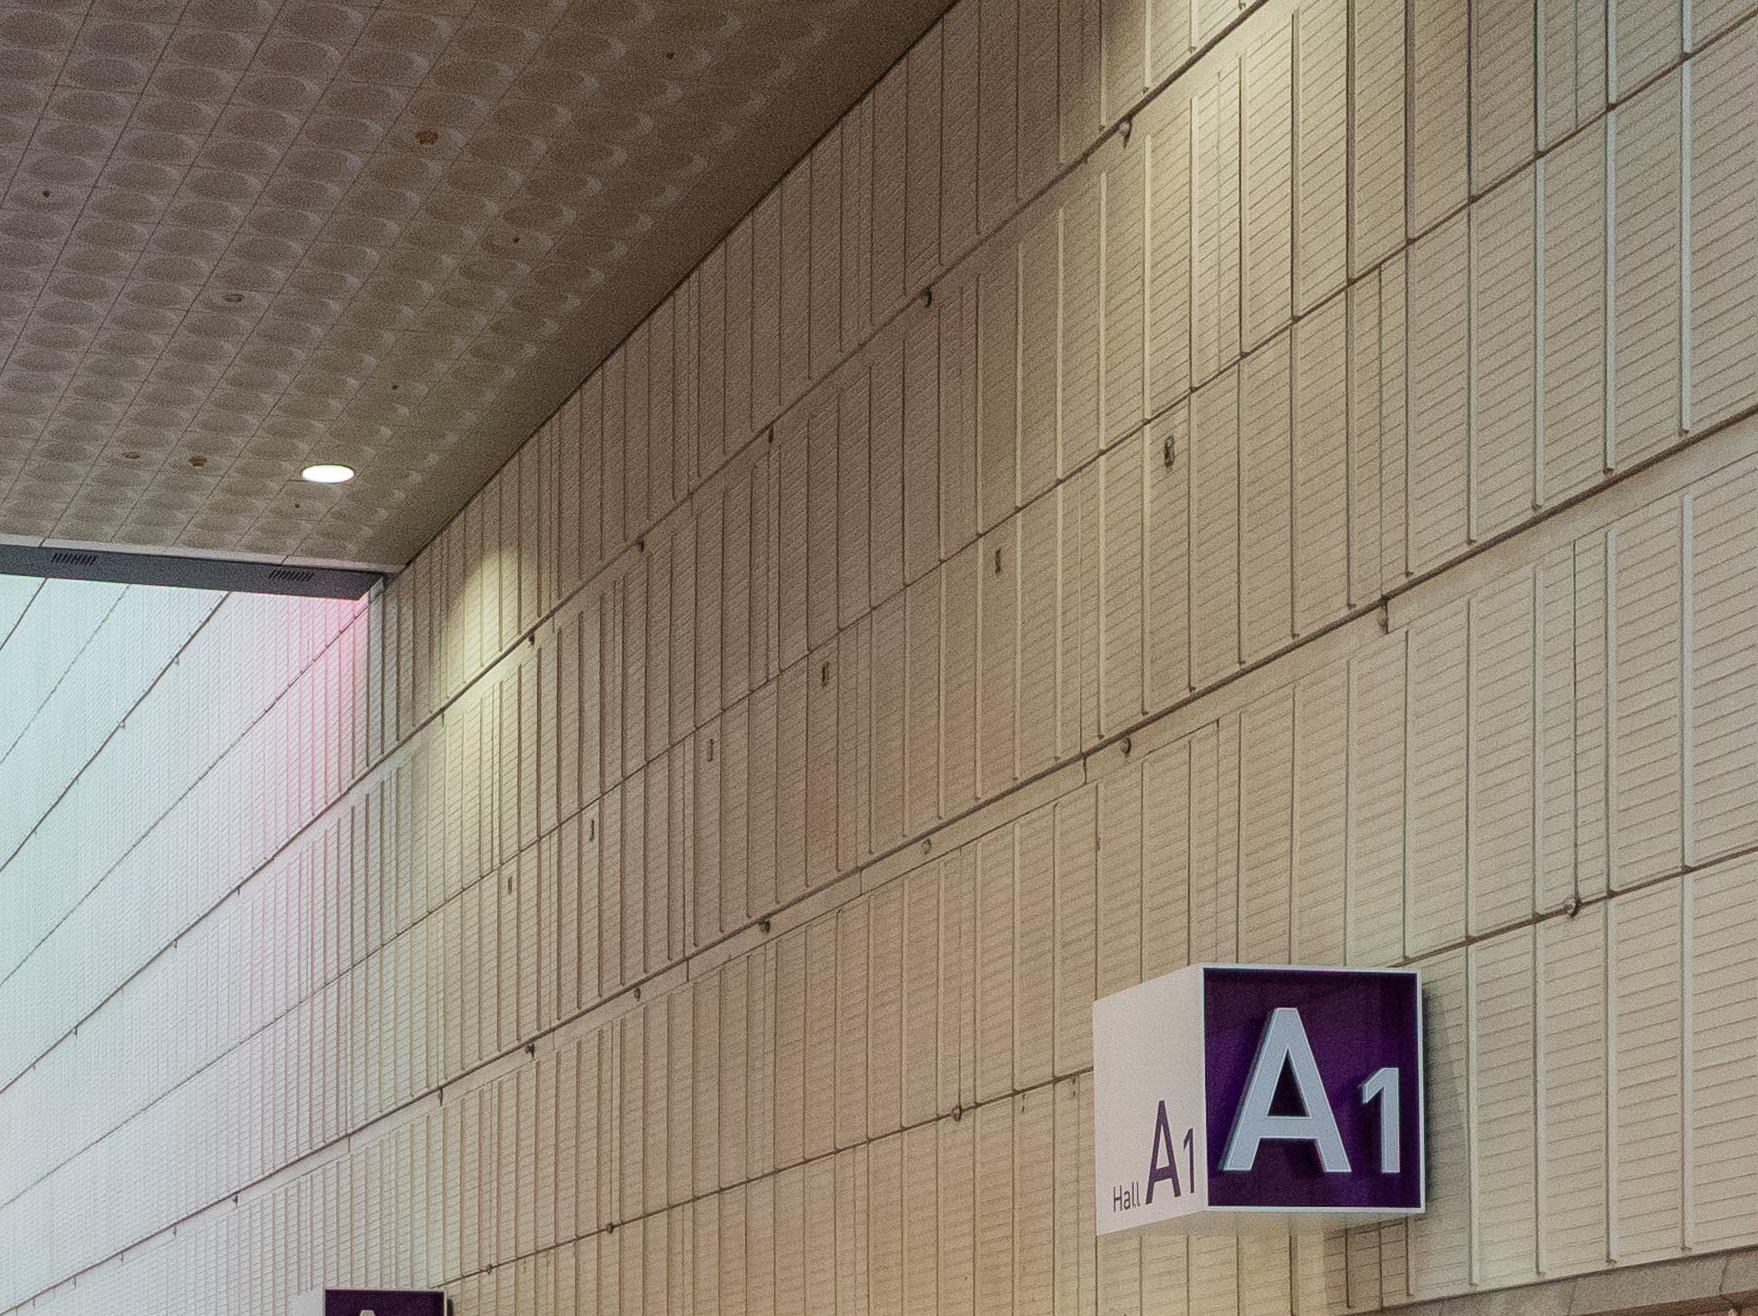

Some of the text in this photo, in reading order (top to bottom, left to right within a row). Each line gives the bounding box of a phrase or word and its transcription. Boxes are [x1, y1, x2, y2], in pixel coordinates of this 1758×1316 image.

[1112, 1100, 1194, 1213] Hall A1
[1220, 1007, 1400, 1174] A1
